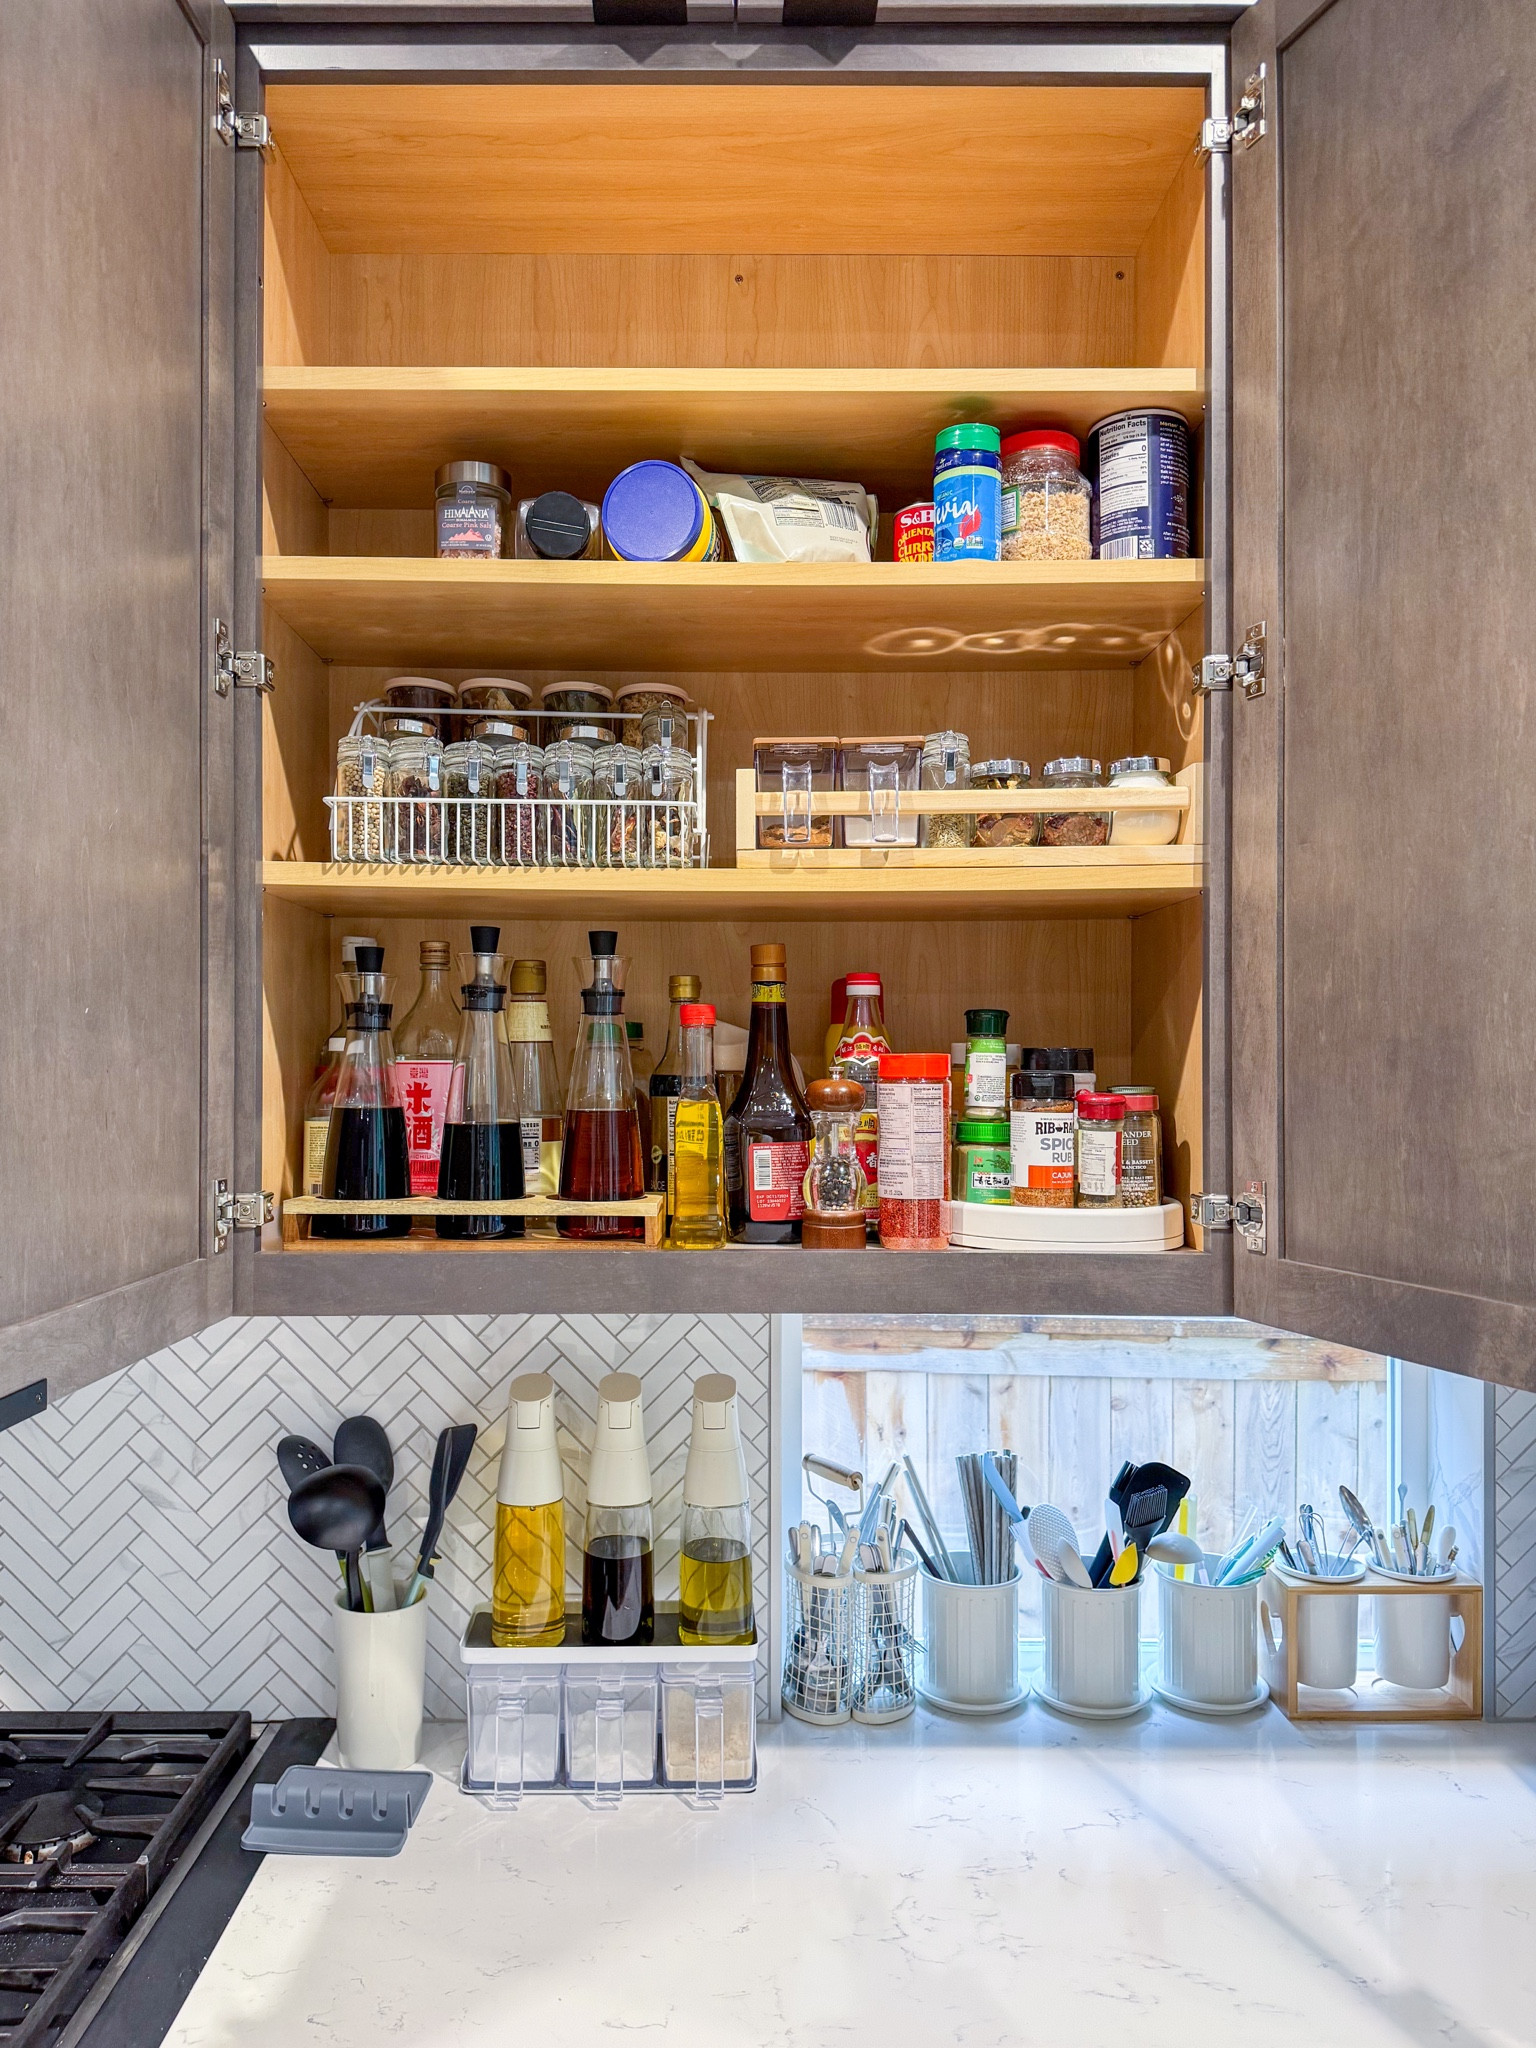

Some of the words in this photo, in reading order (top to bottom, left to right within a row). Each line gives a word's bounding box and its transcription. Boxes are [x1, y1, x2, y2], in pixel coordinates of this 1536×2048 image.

[1100, 424, 1126, 437] Nutrition
[1127, 419, 1147, 428] Facts
[1141, 444, 1147, 452] 0
[1100, 452, 1120, 463] Calories
[441, 521, 462, 529] Coarse
[897, 527, 934, 547] ORIENTA
[405, 1081, 433, 1151] 米酒
[1035, 1121, 1055, 1135] RIB
[1122, 1130, 1152, 1138] ANDER
[1040, 1137, 1073, 1151] SPIC
[1052, 1152, 1072, 1163] RUB
[1052, 1171, 1072, 1179] CAJUN
